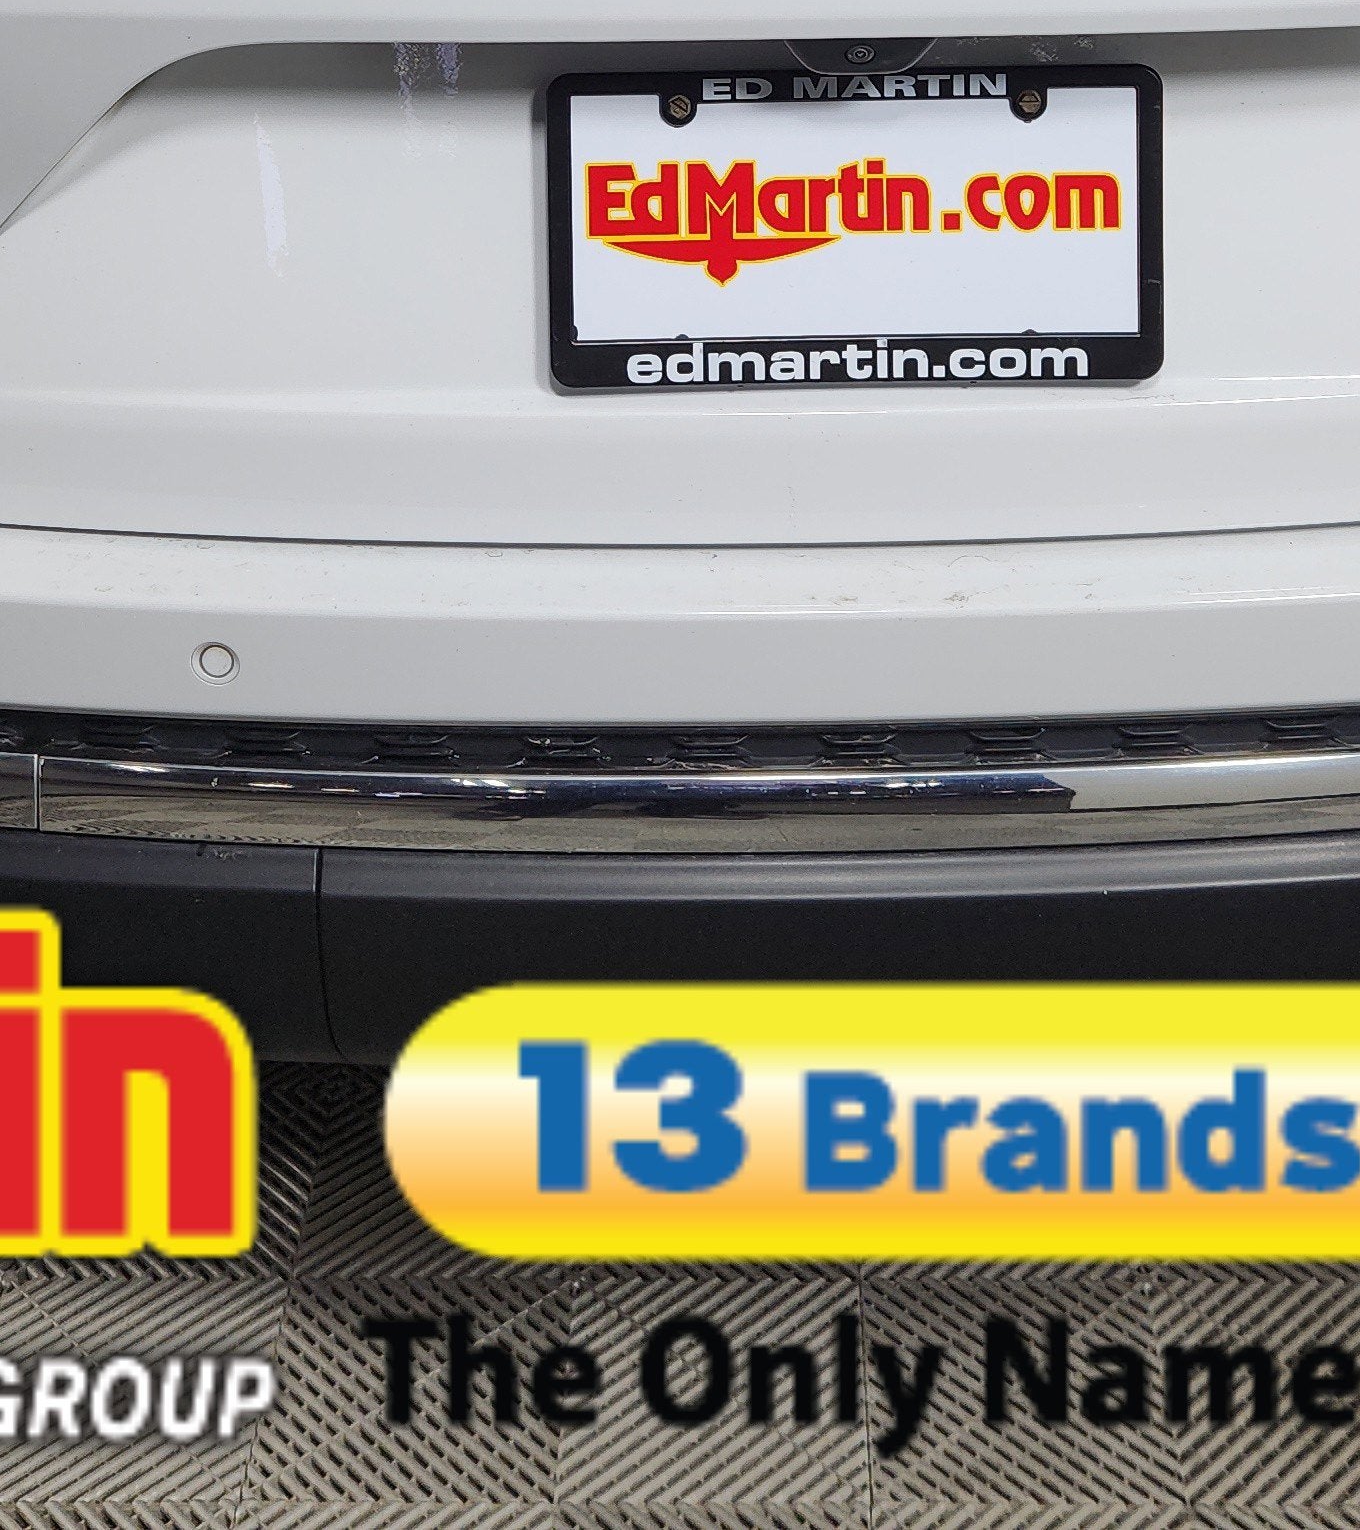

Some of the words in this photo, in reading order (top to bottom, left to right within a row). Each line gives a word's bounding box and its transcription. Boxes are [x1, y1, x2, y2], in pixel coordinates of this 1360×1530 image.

[702, 77, 774, 103] ED
[792, 72, 1009, 101] MARTIN
[626, 340, 1090, 385] edmartin.com
